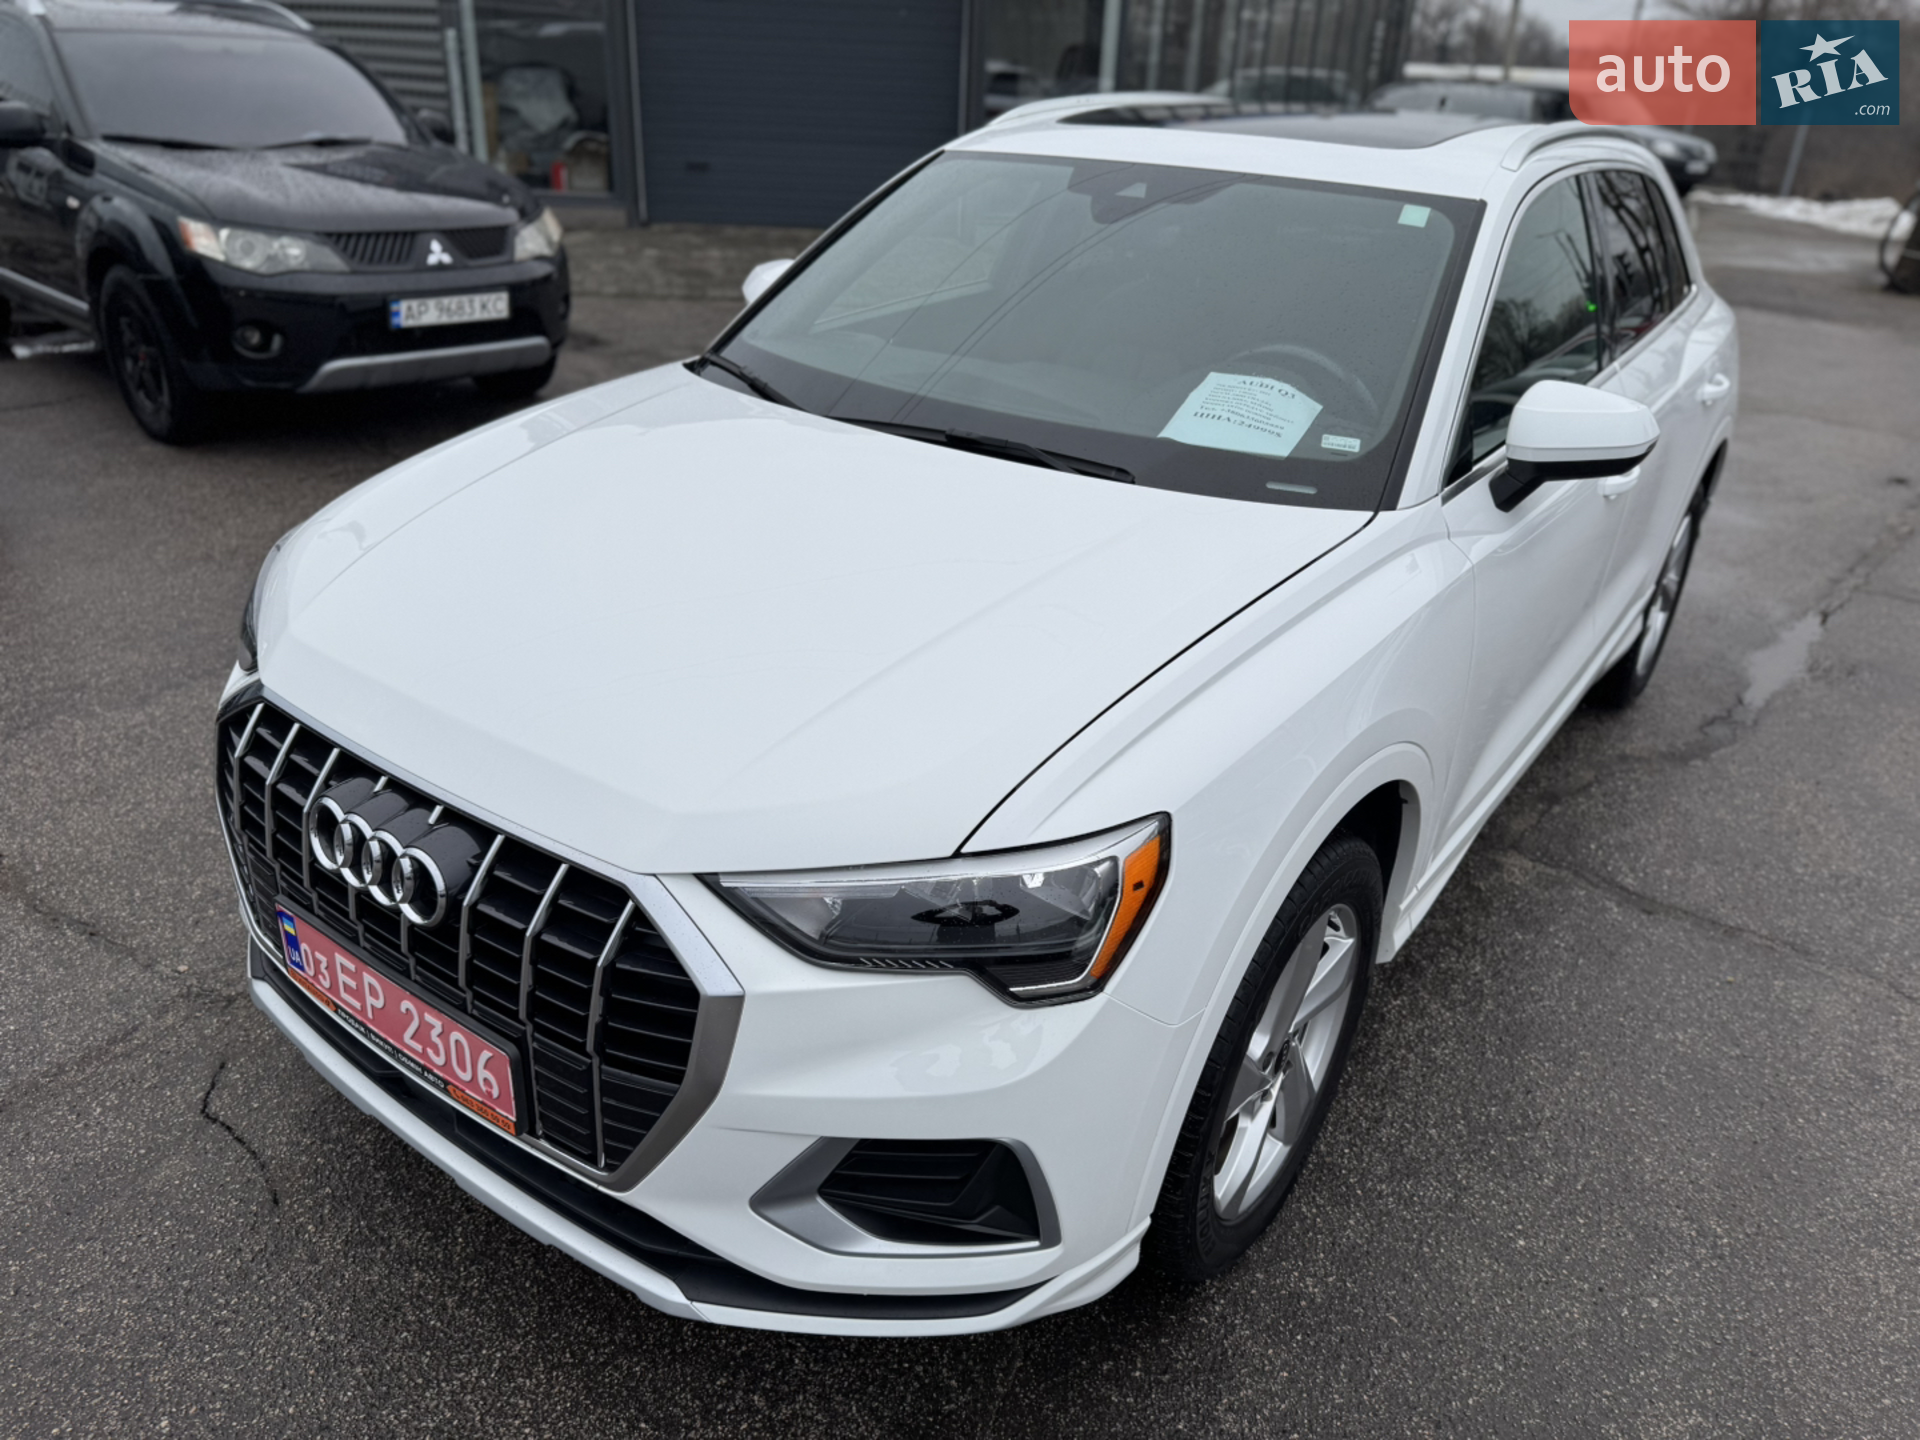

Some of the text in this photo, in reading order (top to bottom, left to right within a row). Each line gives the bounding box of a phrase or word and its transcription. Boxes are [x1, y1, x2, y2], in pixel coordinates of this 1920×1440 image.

[300, 942, 331, 989] 03
[334, 952, 386, 1020] EP
[400, 1000, 500, 1099] 2306
